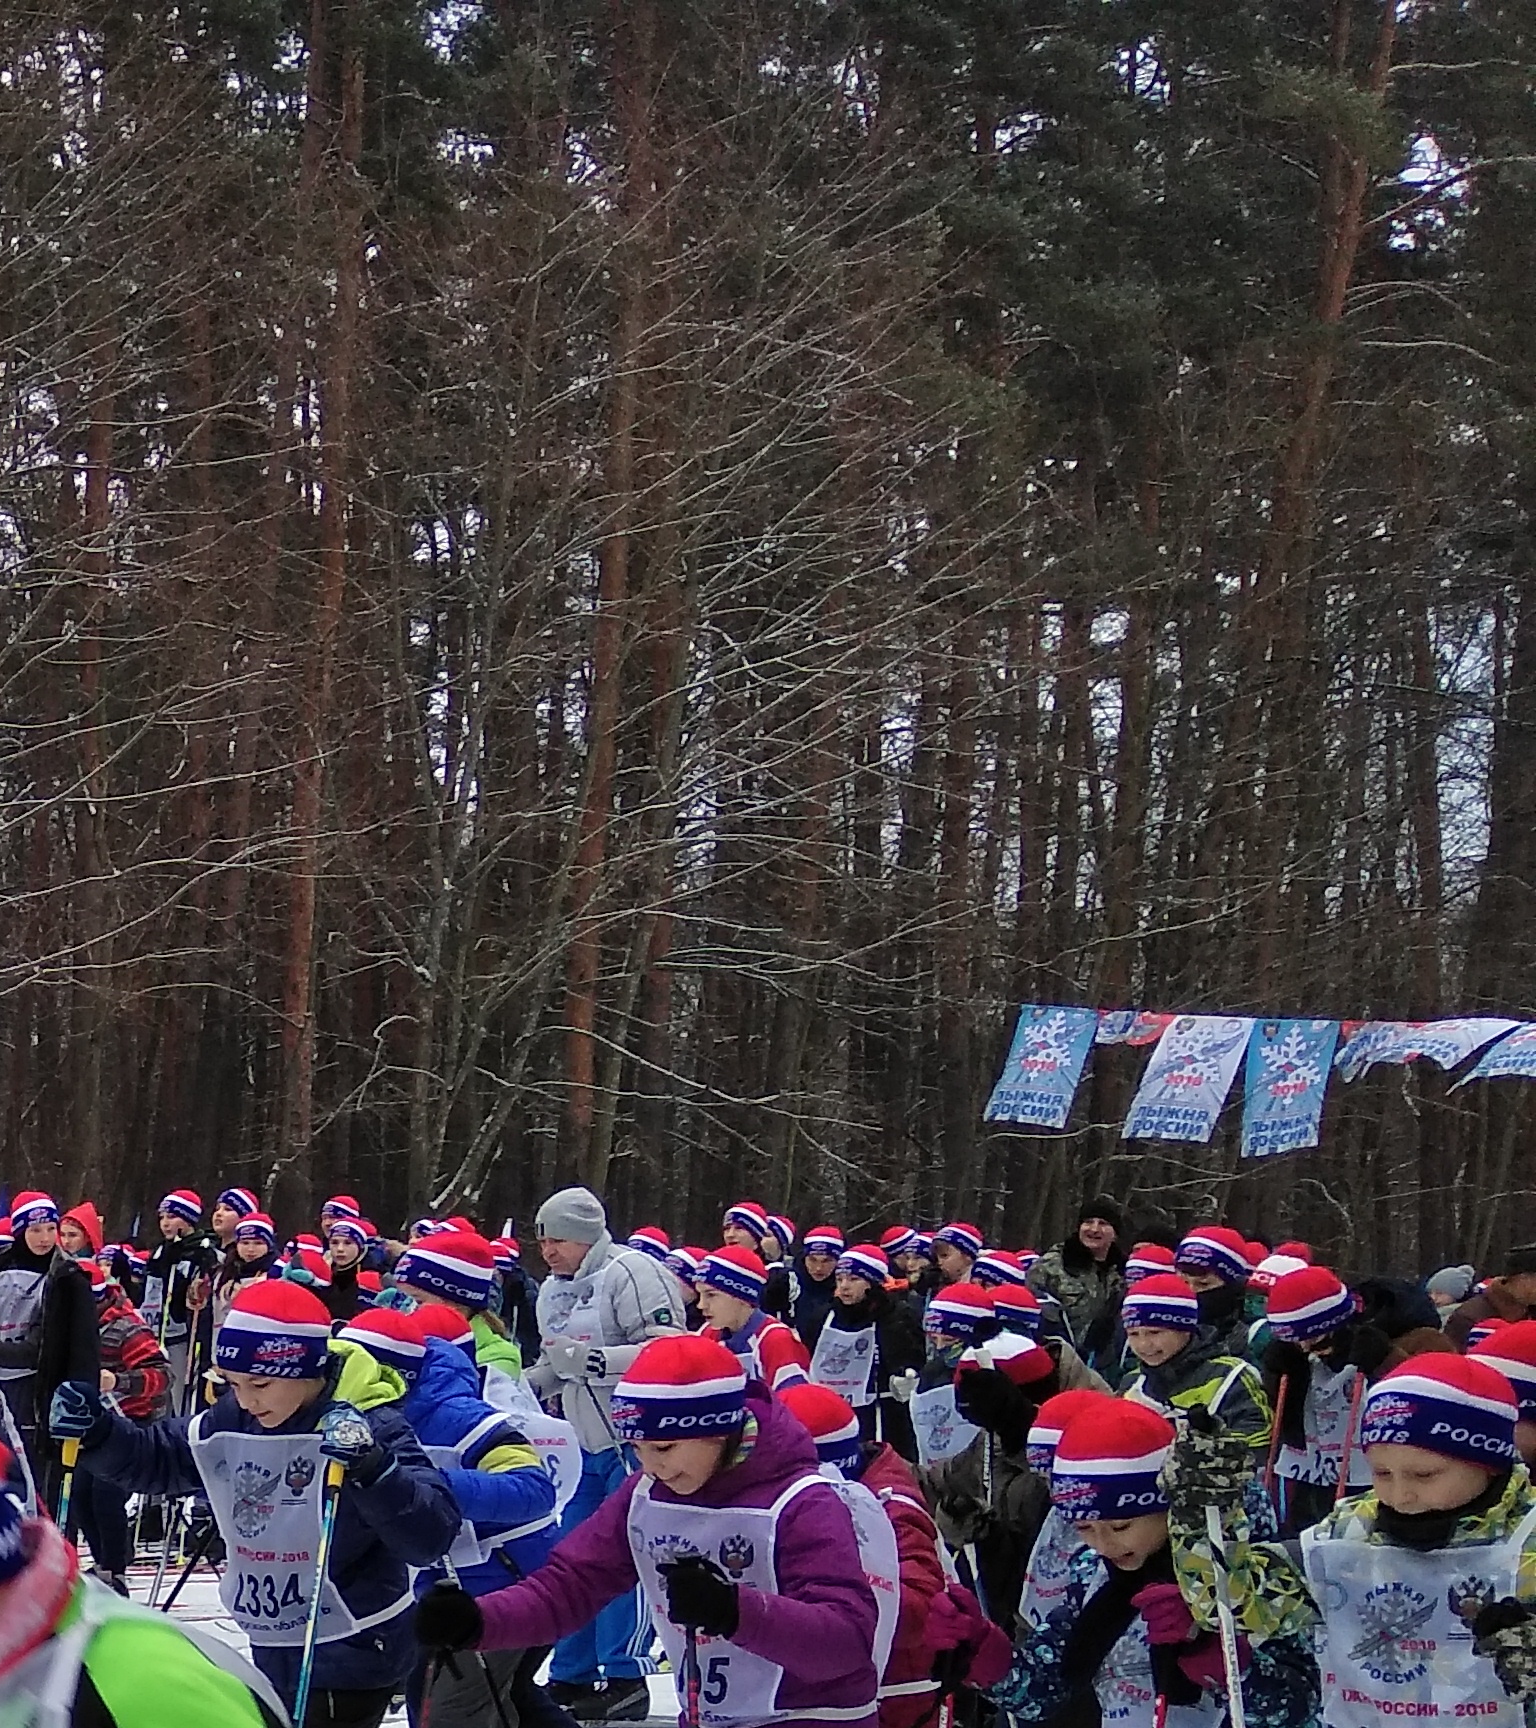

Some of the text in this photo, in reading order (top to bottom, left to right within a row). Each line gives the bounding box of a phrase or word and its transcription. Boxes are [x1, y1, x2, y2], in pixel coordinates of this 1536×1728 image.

[997, 1090, 1064, 1105] ЛЫЖНЯ
[991, 1103, 1059, 1119] РОССИИ
[1136, 1106, 1209, 1122] ЛЫЖНЯ
[1132, 1119, 1203, 1137] РОССИИ
[1249, 1112, 1313, 1133] ЛЫЖНЯ
[1249, 1127, 1310, 1150] РОССИИ
[250, 1362, 303, 1378] 2018
[1362, 1428, 1410, 1445] 2018
[282, 1551, 310, 1563] 2018
[1365, 1582, 1425, 1603] ЛЫЖНЯ
[1399, 1638, 1436, 1651] 2018
[1360, 1661, 1428, 1684] РОССИИ
[1455, 1702, 1499, 1718] 2018
